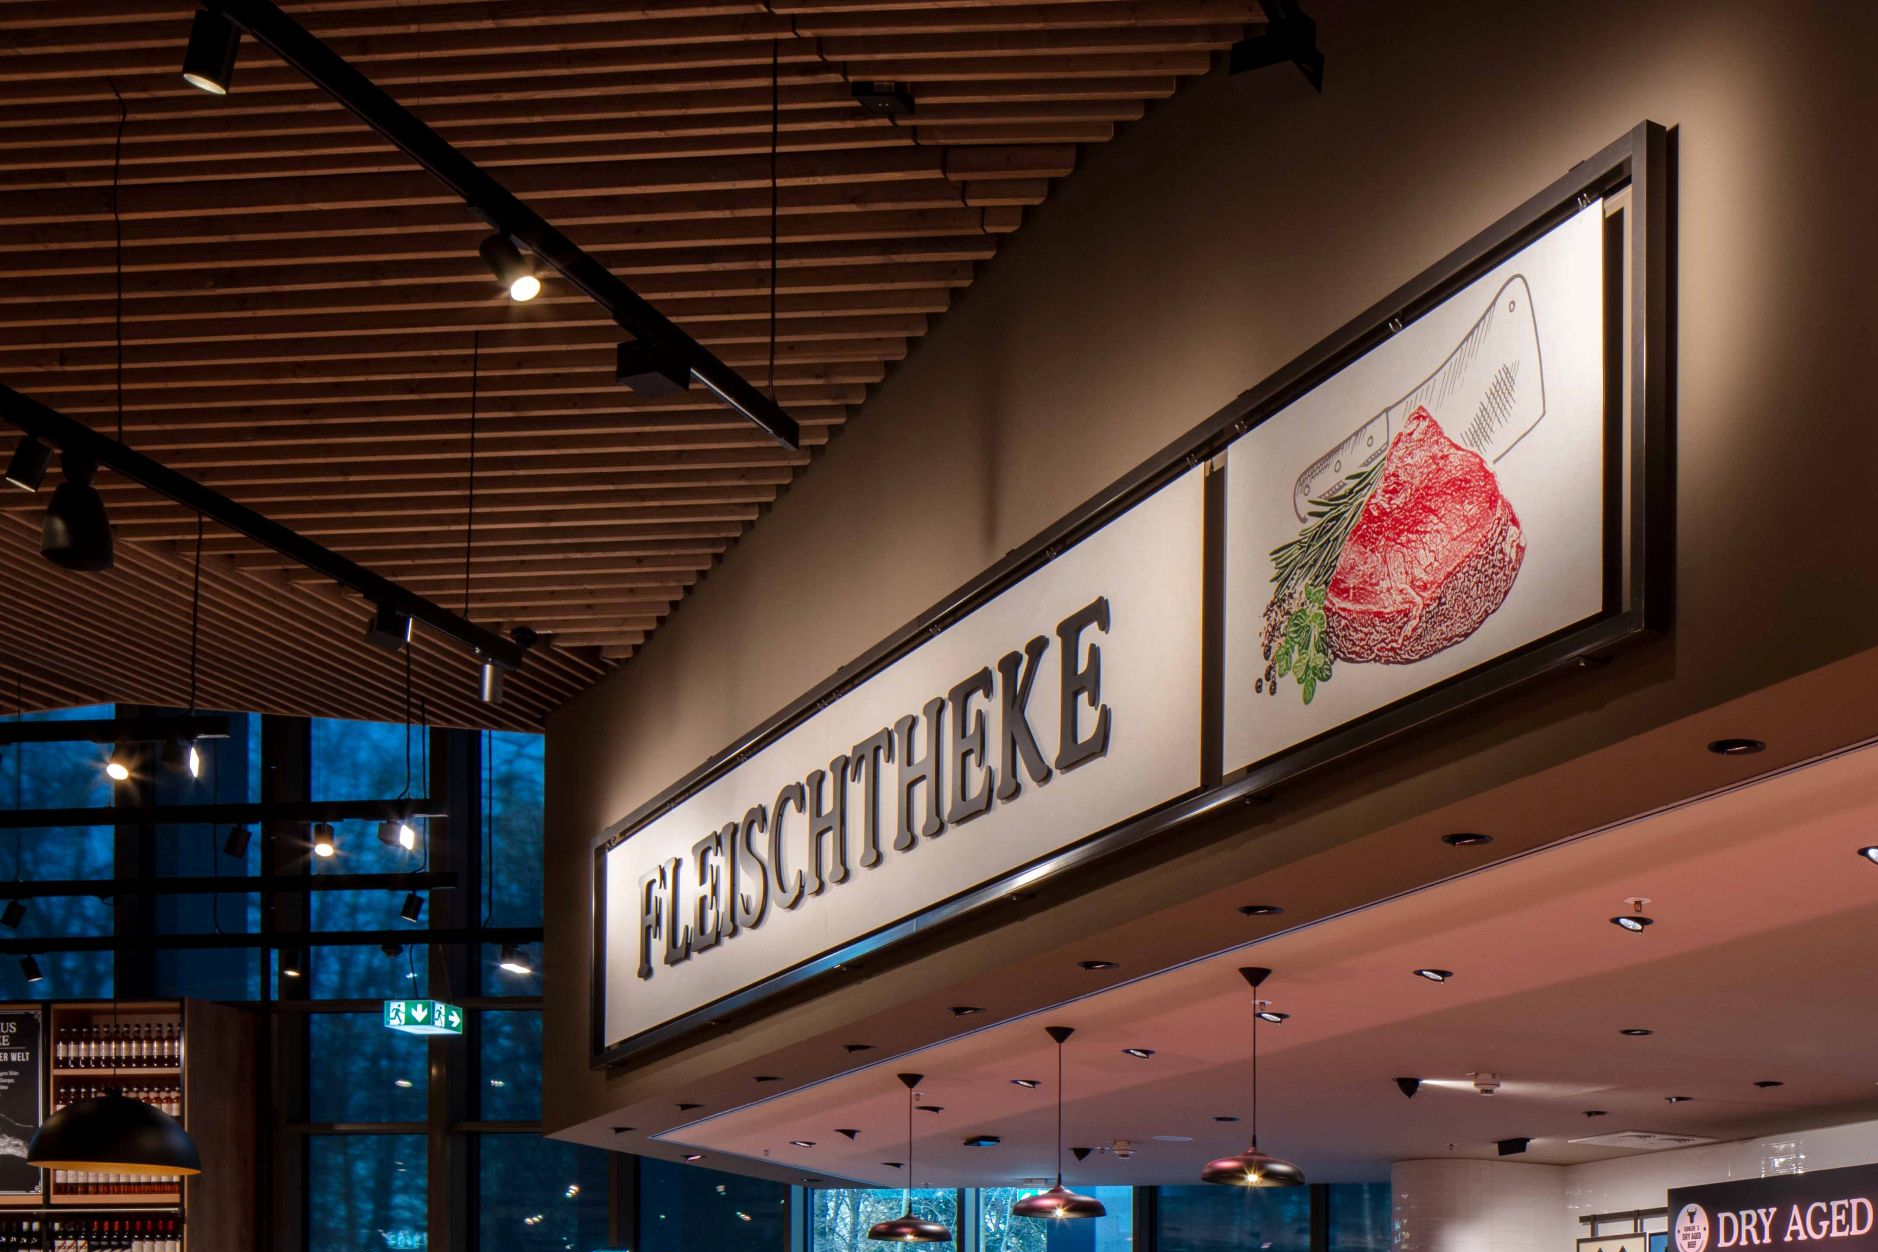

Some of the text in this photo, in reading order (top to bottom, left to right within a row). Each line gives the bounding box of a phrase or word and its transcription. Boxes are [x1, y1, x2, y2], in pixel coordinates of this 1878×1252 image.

[637, 595, 1110, 980] FLEISCHTHEKE
[0, 1022, 17, 1033] US
[10, 1052, 30, 1061] WELT
[1717, 1197, 1874, 1248] DRY AGED
